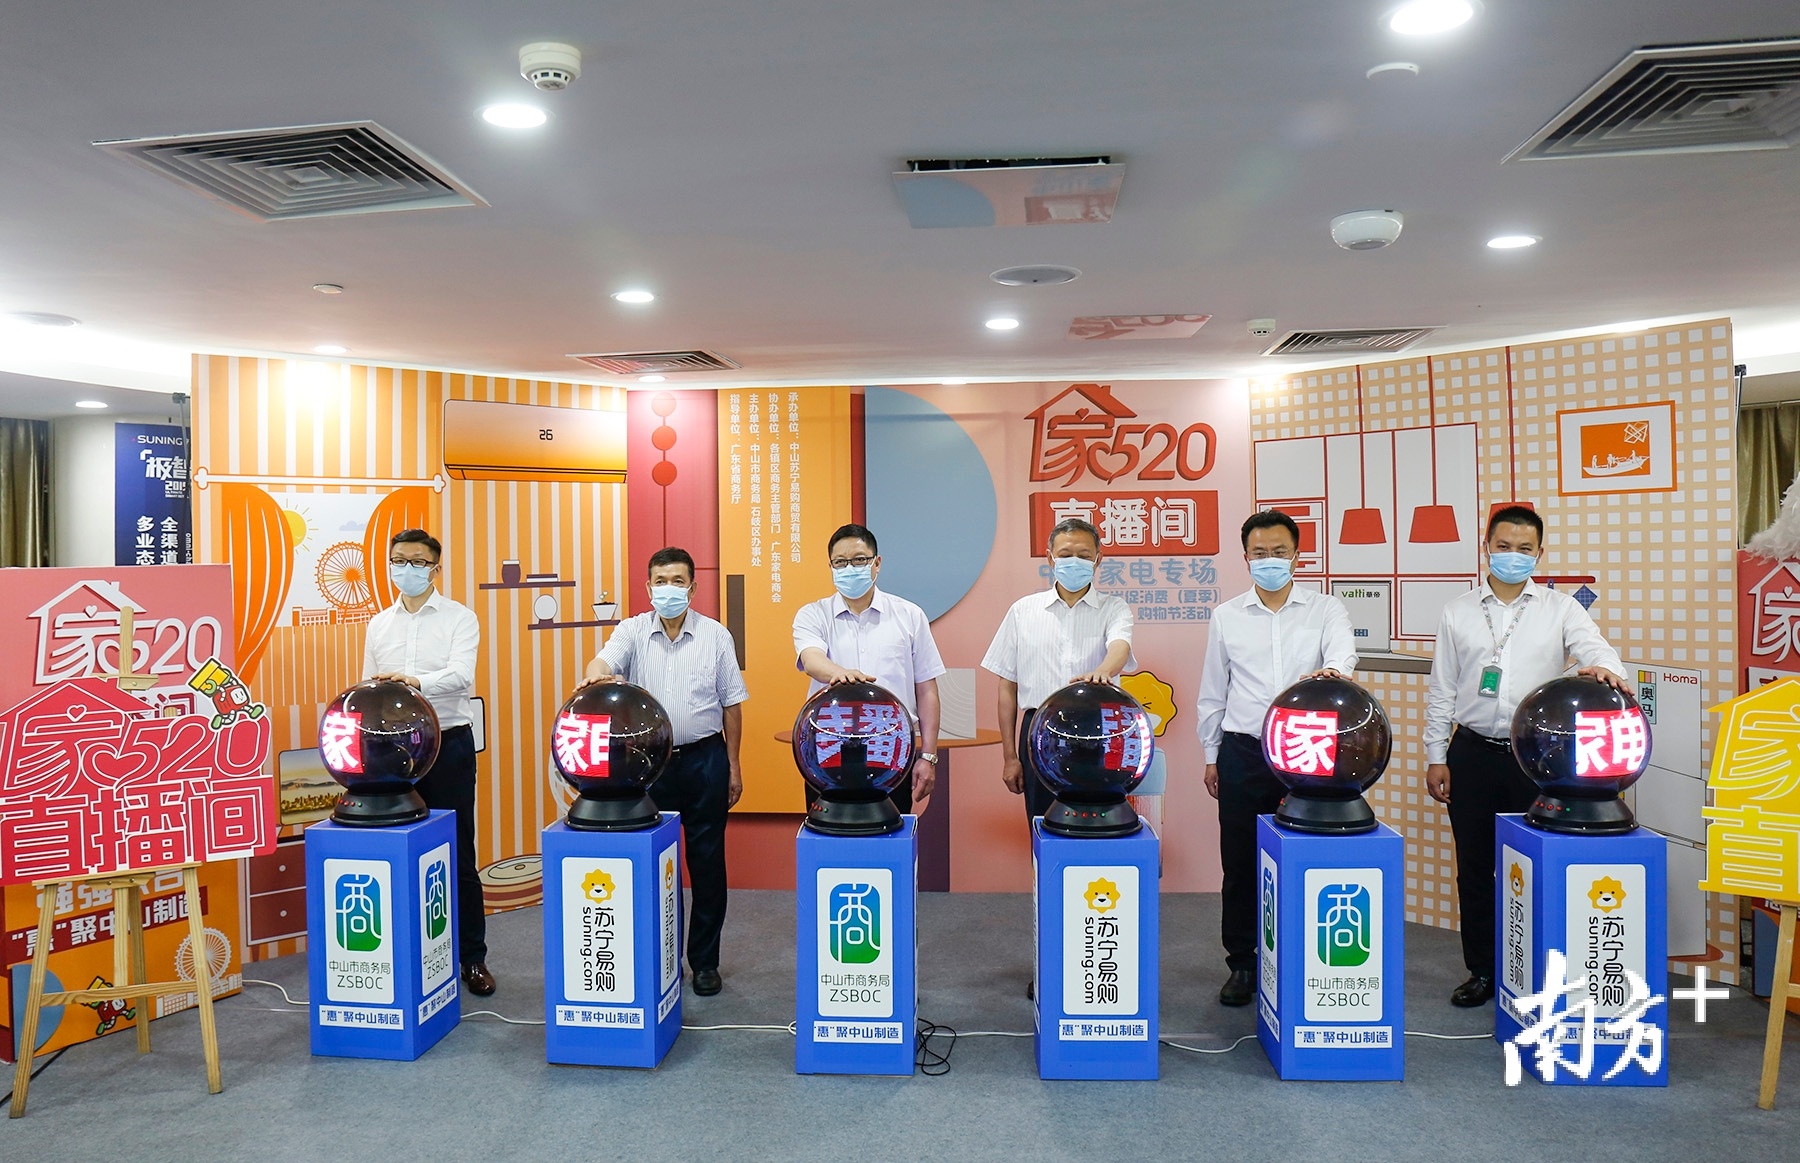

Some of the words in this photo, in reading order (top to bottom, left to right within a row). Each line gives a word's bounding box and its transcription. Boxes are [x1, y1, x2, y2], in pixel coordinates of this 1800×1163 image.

[137, 435, 183, 445] SUNING
[539, 429, 553, 441] 26
[135, 515, 155, 566] 多业态
[160, 516, 179, 566] 全渠道
[771, 541, 782, 603] 广东家电商会
[1038, 559, 1217, 586] 中家电专场
[1341, 588, 1365, 598] vatti
[1137, 606, 1211, 620] 购物节活动
[1663, 672, 1698, 685] Homa
[1641, 687, 1654, 717] 奥马
[580, 906, 593, 991] suning.com
[594, 906, 615, 992] 苏宁易购
[328, 960, 391, 975] 中山市商务局
[427, 953, 448, 980] ZSBOC
[1081, 916, 1094, 1004] suning.com
[1097, 916, 1119, 1004] 苏宁易购
[1602, 916, 1625, 1007] 苏宁易购
[337, 975, 383, 990] ZSBOC
[820, 973, 890, 988] 中山市商务局
[1307, 977, 1380, 991] 中山市商务局
[829, 988, 881, 1003] ZSBOC
[1316, 992, 1370, 1007] ZSBOC
